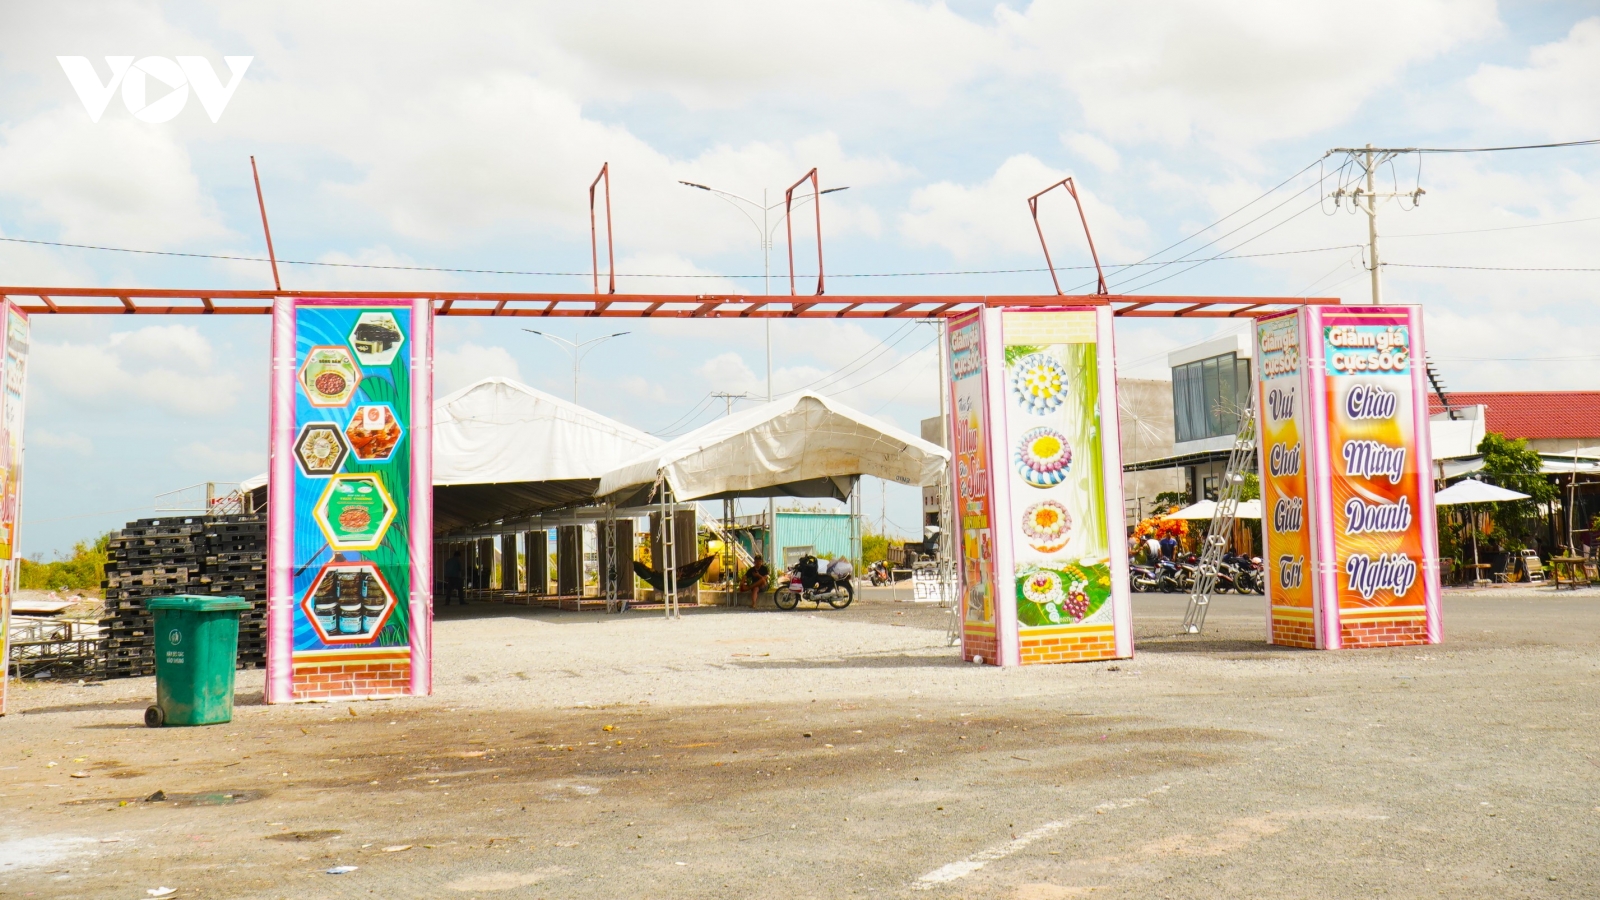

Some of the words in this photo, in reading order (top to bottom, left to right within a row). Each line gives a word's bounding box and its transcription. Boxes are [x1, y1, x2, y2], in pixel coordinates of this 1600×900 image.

[1329, 327, 1376, 349] Giảm
[1375, 327, 1406, 352] giá
[1332, 352, 1368, 375] Cực
[1269, 388, 1294, 420] Vui
[1347, 384, 1396, 419] Chào
[1270, 442, 1301, 478] Chơi
[1344, 441, 1405, 483] Mừng
[1274, 498, 1302, 534] Giải
[1346, 497, 1411, 533] Doanh
[1279, 555, 1303, 590] Trí
[1347, 554, 1415, 599] Nghiệp
